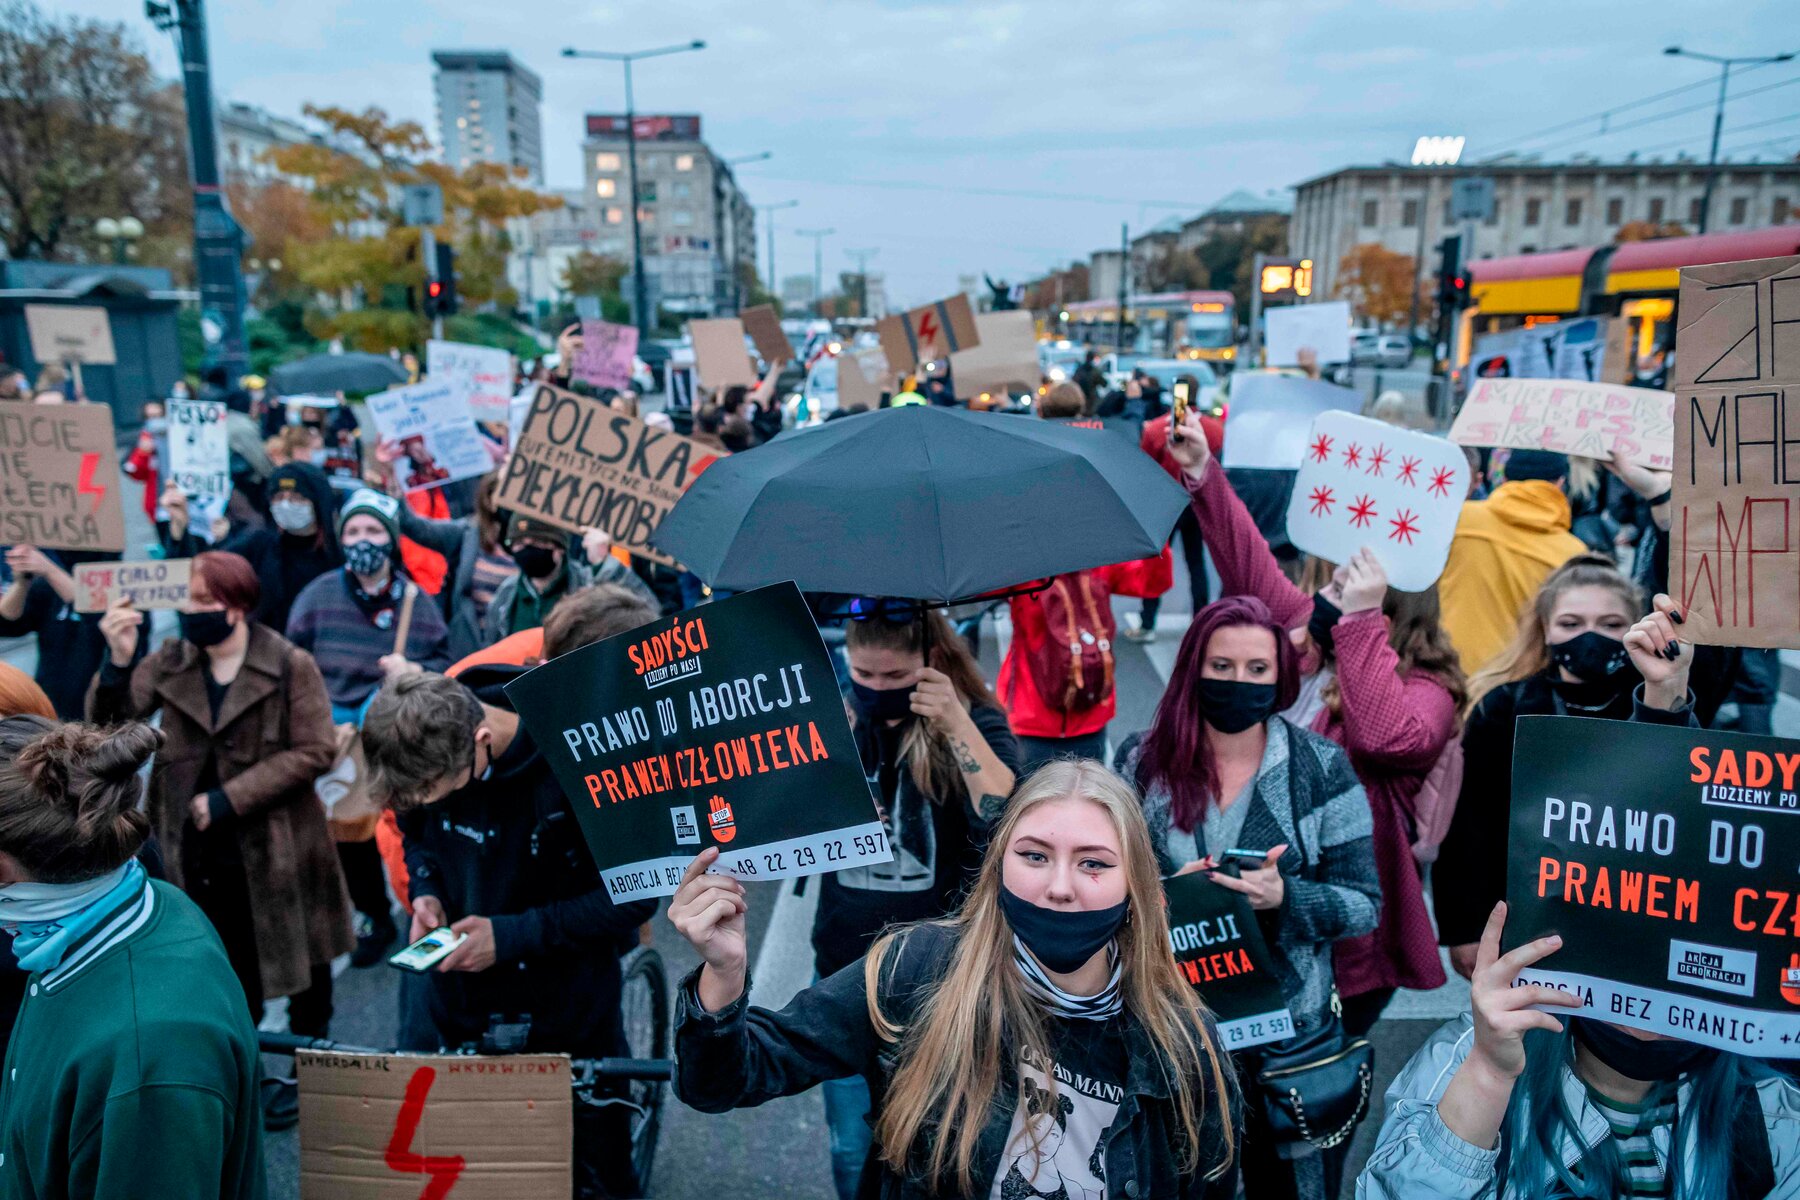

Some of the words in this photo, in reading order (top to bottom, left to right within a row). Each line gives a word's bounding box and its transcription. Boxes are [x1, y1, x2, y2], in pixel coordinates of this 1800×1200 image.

[522, 386, 692, 488] POLSKA
[1681, 495, 1800, 630] WYP
[628, 616, 709, 675] SADYŚCI
[669, 663, 679, 677] PO
[563, 706, 650, 762] PRAWO
[656, 697, 677, 736] DO
[689, 663, 811, 729] ABORCJI
[584, 751, 673, 808] PRAWEM
[677, 721, 829, 789] CZŁOWIEKA
[1689, 746, 1800, 790] SADY
[714, 809, 728, 821] STOP
[1711, 785, 1772, 805] IDZIEMY
[1779, 792, 1797, 808] PO
[1543, 797, 1676, 856] PRAWO
[1708, 819, 1764, 868] DO
[609, 869, 662, 895] ABORCJA
[730, 858, 757, 876] +48
[764, 853, 787, 872] 22
[793, 847, 816, 867] 29
[823, 841, 847, 861] 22
[853, 832, 885, 856] 597
[1537, 856, 1700, 923] PRAWEM
[1680, 964, 1742, 983] DEMOKRACJA
[1687, 953, 1719, 967] AKCJA
[1228, 1028, 1244, 1042] 29
[1249, 1023, 1265, 1037] 22
[1269, 1017, 1290, 1033] 597
[1611, 993, 1651, 1020] BEZ
[1668, 1005, 1764, 1044] GRANIC:
